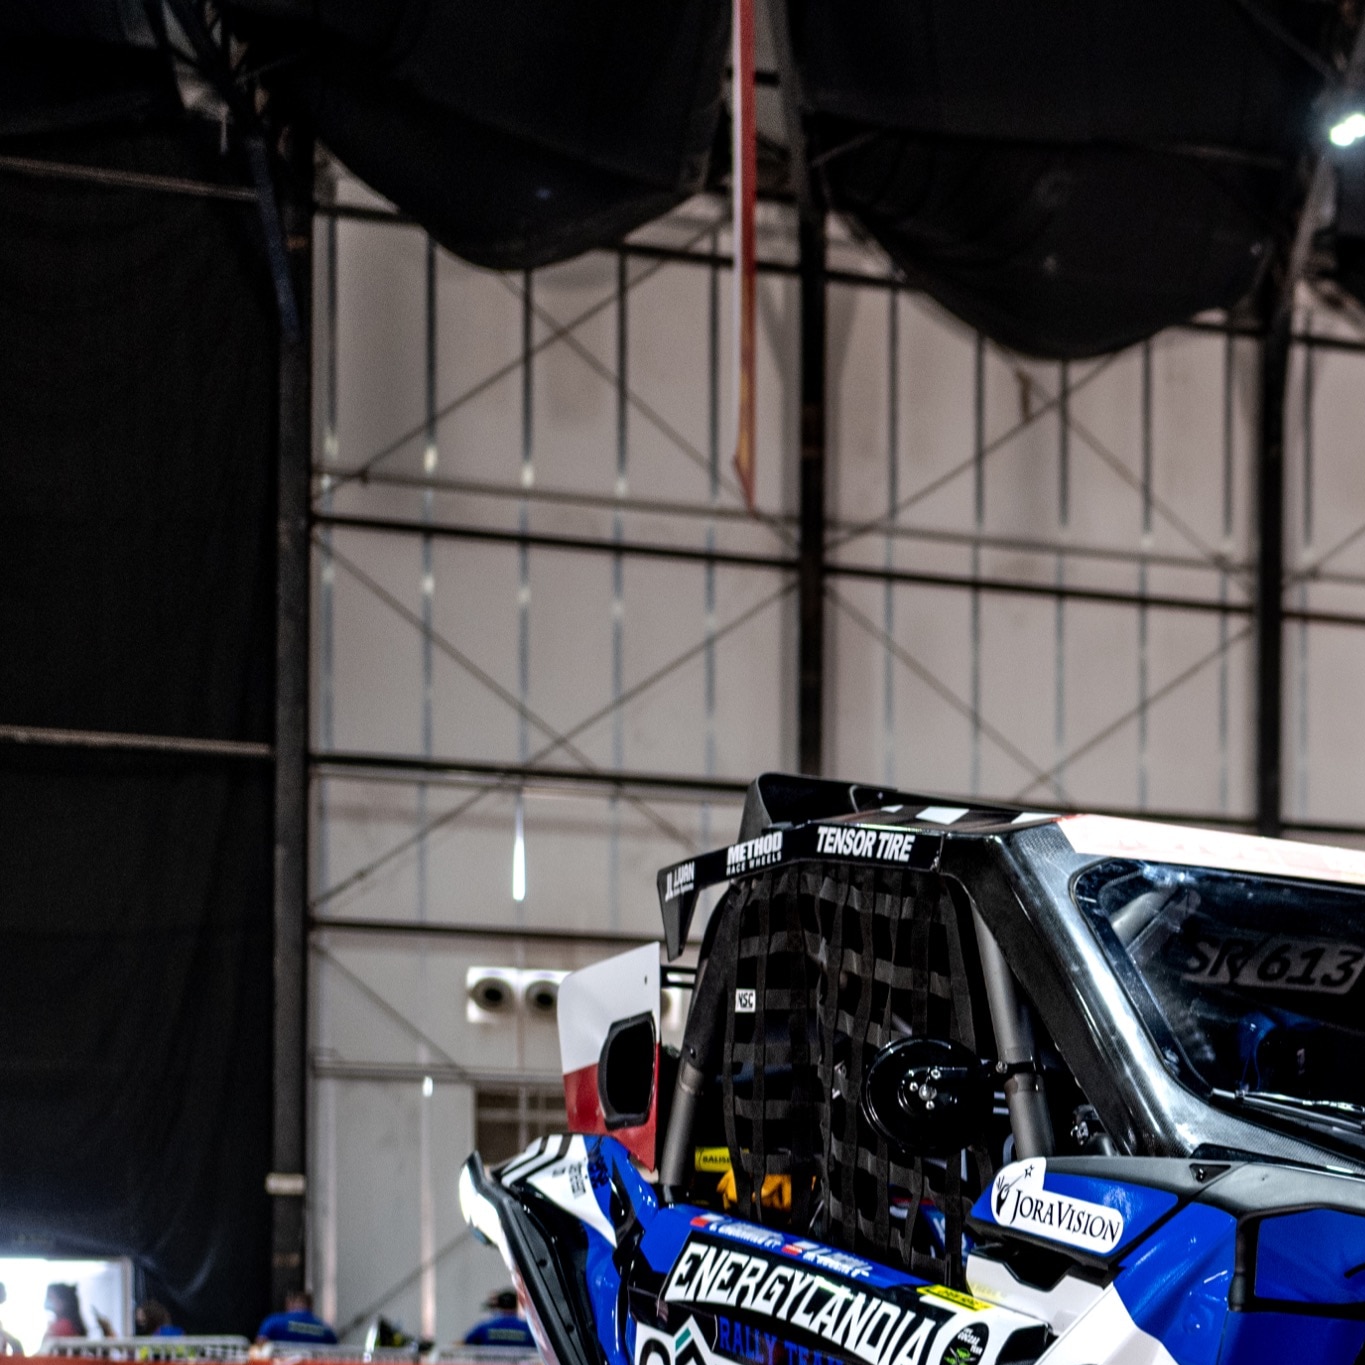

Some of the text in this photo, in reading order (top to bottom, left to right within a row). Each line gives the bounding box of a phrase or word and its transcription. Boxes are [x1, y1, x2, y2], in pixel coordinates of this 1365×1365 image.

[727, 831, 783, 865] METHOD
[817, 826, 915, 862] TENSOR TIRE
[726, 851, 782, 876] RACE WHEELS
[1187, 938, 1363, 987] SR 613
[719, 1316, 778, 1365] RALLY
